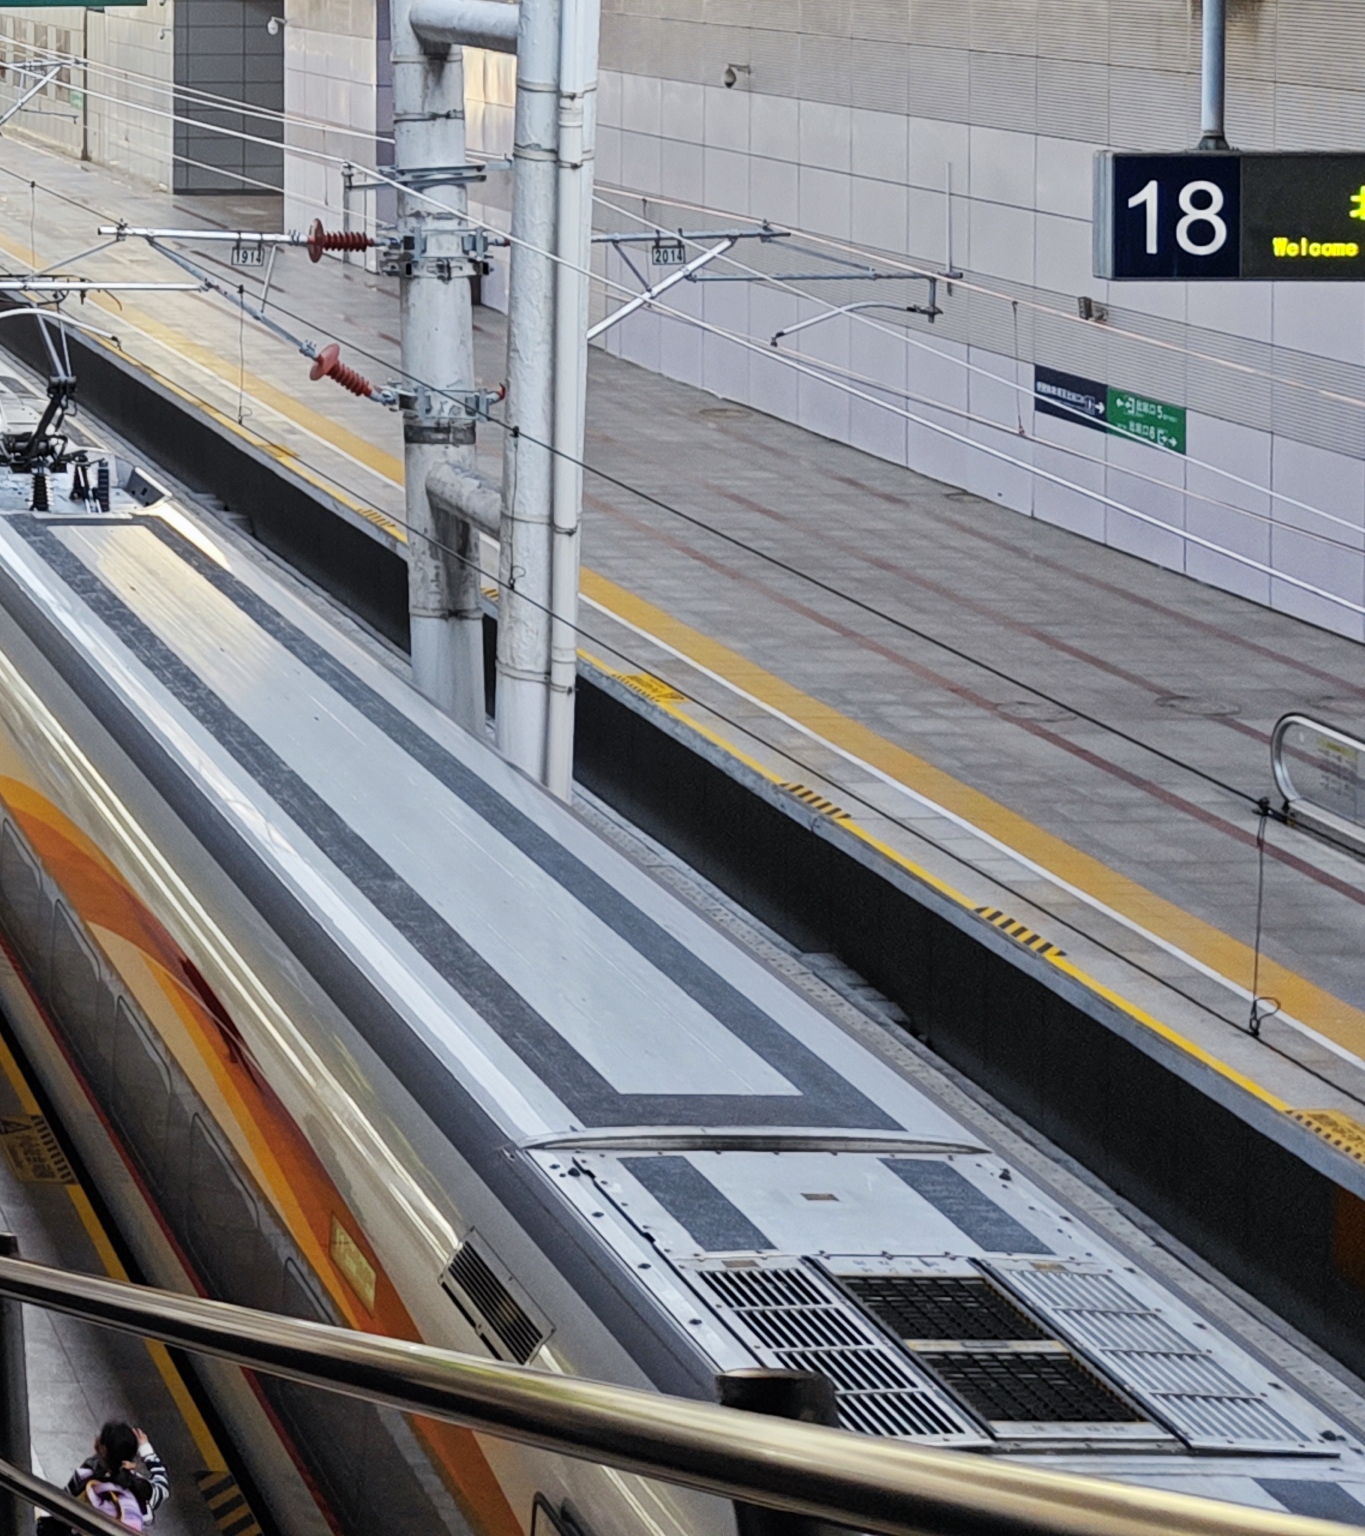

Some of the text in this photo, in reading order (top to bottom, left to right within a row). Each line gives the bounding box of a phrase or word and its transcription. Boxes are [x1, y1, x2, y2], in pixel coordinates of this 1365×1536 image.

[1128, 180, 1227, 256] 18
[655, 248, 683, 263] 2014
[1272, 237, 1359, 257] Welcome
